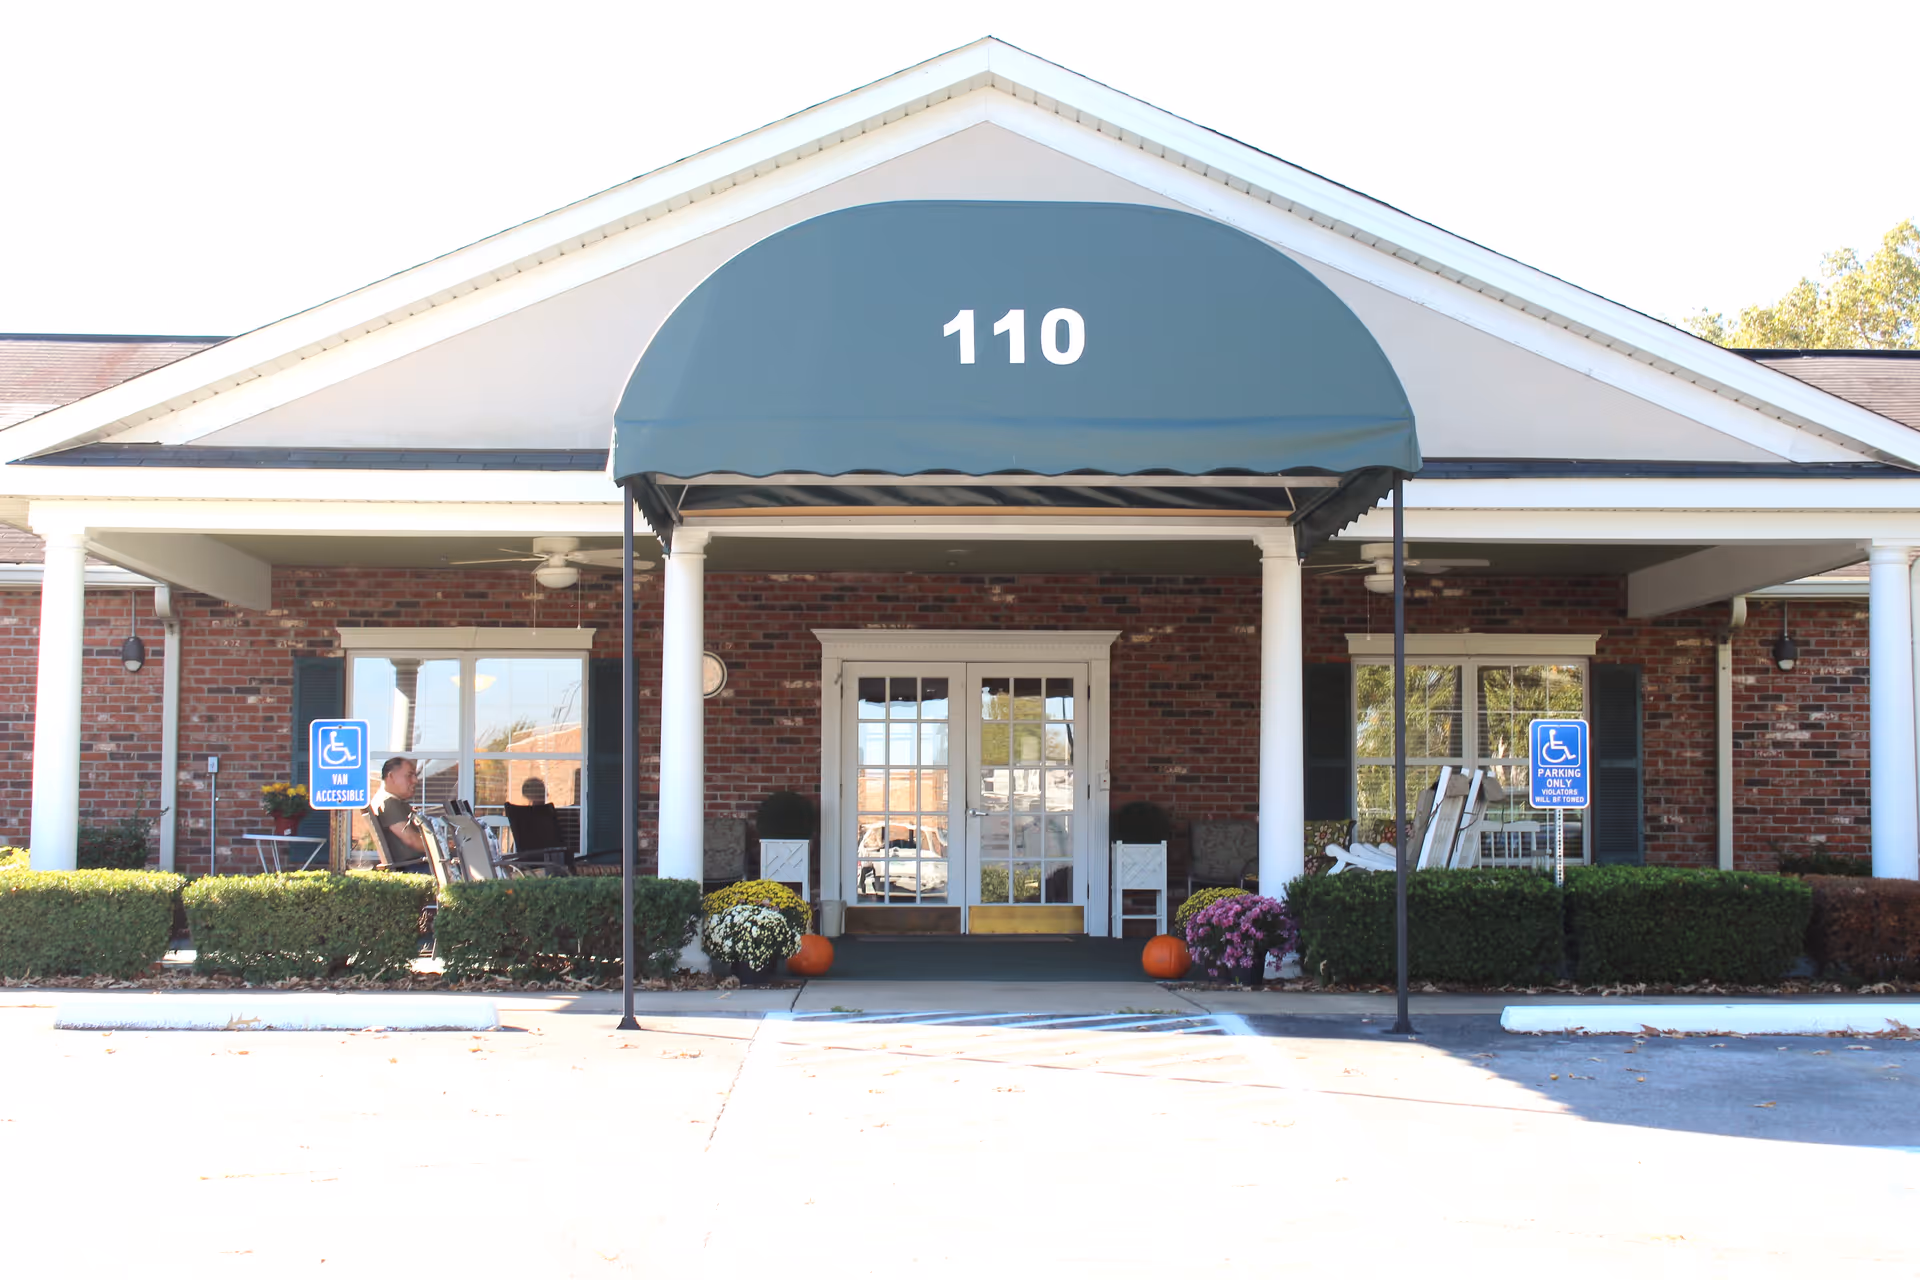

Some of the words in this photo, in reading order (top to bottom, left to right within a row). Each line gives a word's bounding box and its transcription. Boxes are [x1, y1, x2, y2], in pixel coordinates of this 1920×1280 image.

[943, 307, 1085, 365] 110
[1538, 768, 1581, 777] PARKING
[332, 773, 348, 785] VAN
[1546, 779, 1572, 788] ONLY
[316, 789, 365, 802] ACCESSIBLE
